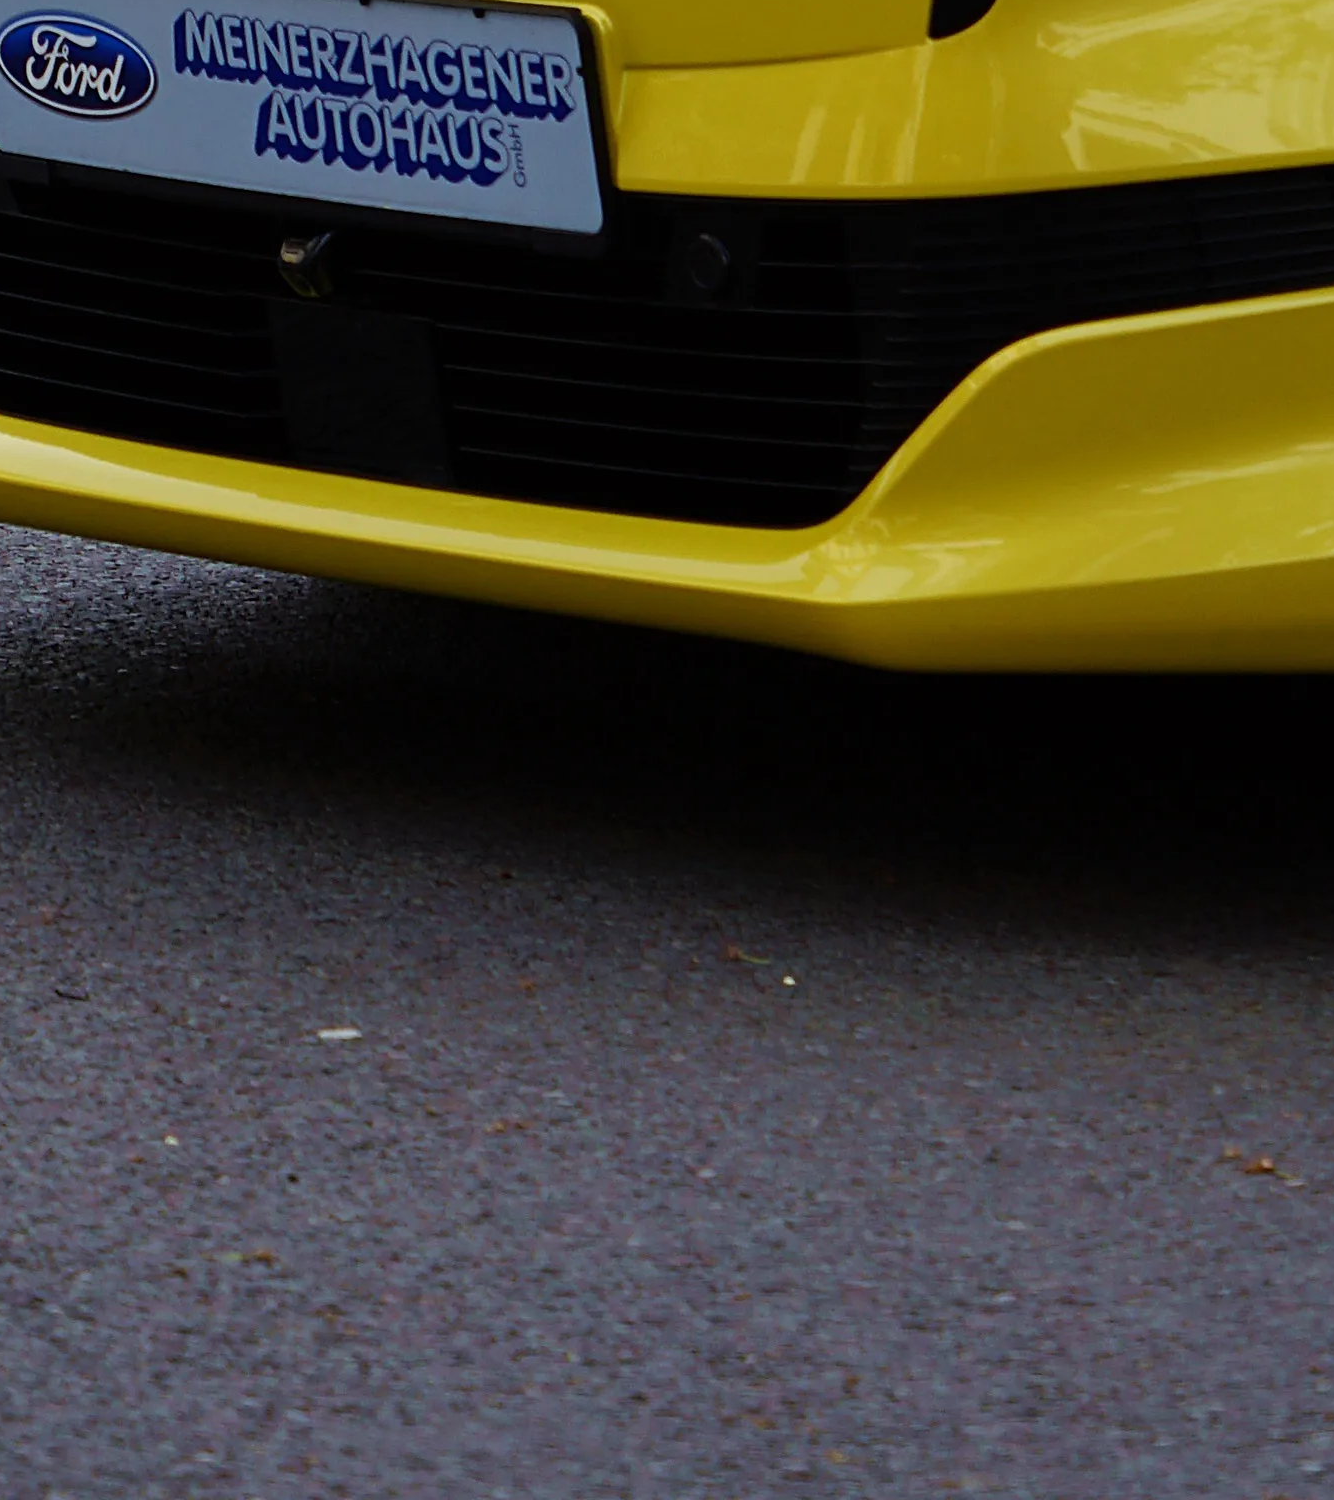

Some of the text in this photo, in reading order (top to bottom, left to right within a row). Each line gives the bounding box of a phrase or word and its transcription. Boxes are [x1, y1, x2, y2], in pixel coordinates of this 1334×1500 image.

[25, 7, 577, 123] Ford MEINERZHAGENER
[254, 91, 510, 188] AUTOHAUS
[508, 122, 528, 188] GmbH
